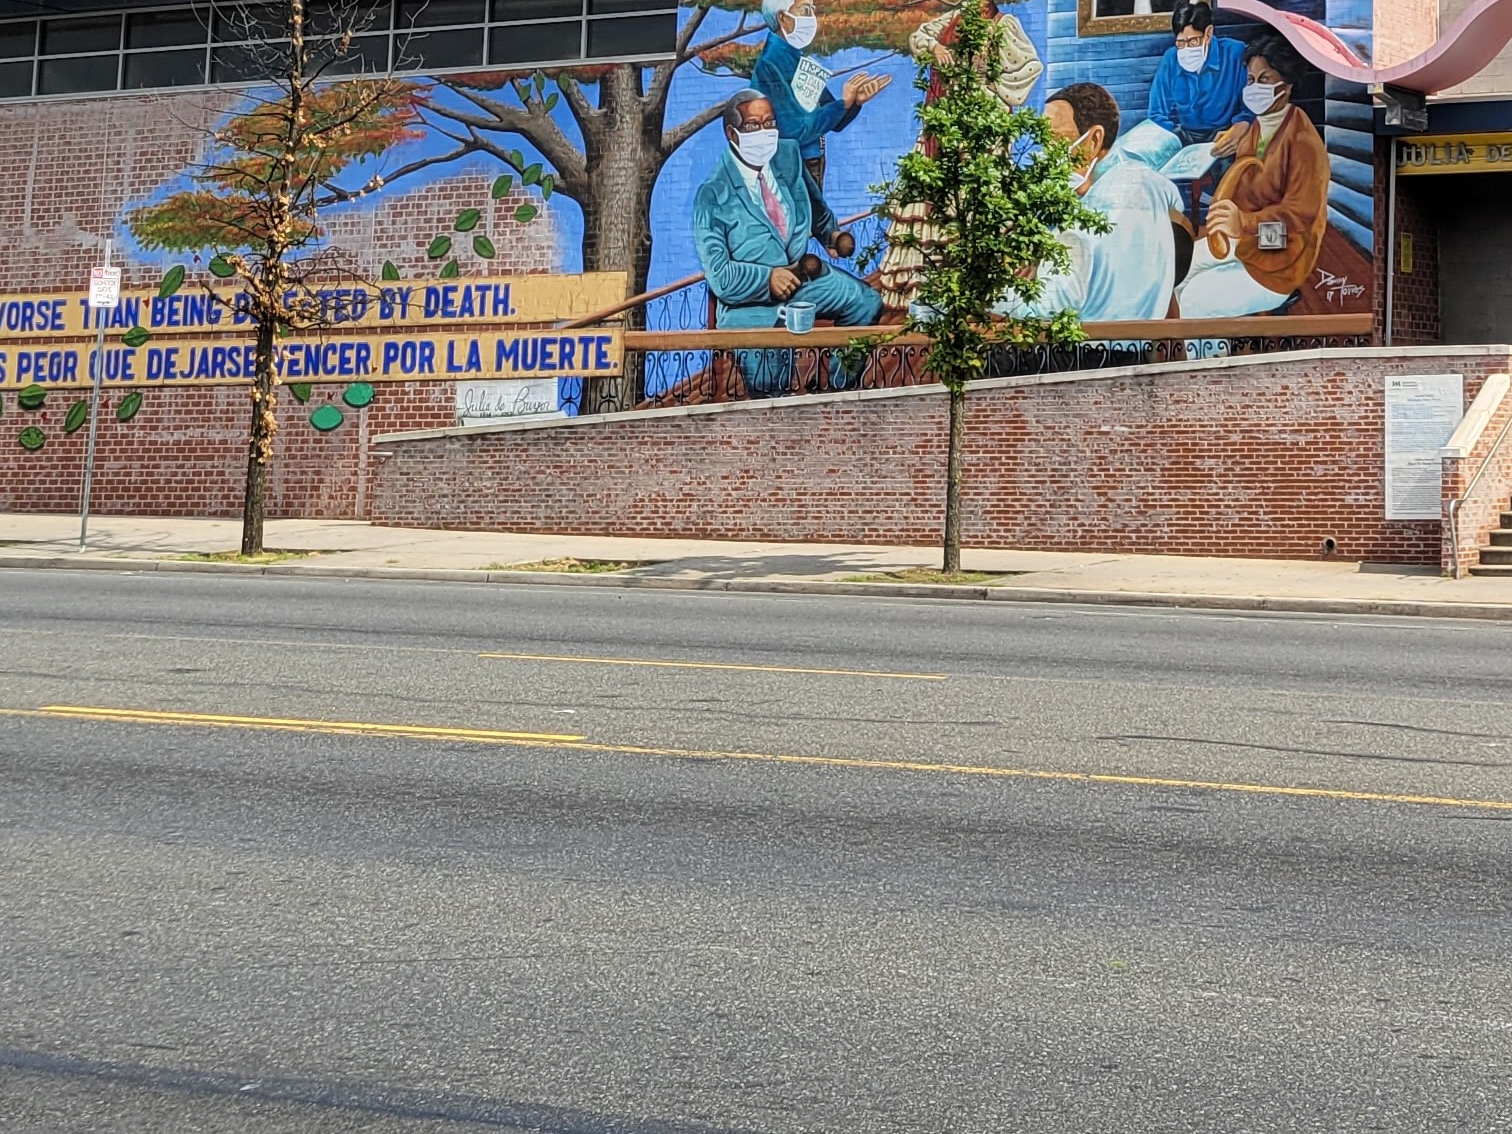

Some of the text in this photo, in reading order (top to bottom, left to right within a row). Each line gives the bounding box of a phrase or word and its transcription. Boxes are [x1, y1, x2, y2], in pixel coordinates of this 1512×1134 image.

[1397, 144, 1469, 166] JULIA
[1486, 144, 1512, 163] DE
[80, 296, 141, 330] THAN
[151, 293, 223, 328] BEING
[379, 285, 413, 320] BY
[424, 282, 516, 319] DEATH.
[16, 351, 78, 383] PEOR
[89, 349, 137, 384] QUE
[147, 345, 257, 381] DEJARSE
[271, 342, 372, 377] VENCER
[382, 340, 436, 376] POR
[445, 338, 482, 373] LA
[495, 335, 619, 373] MUERTE.
